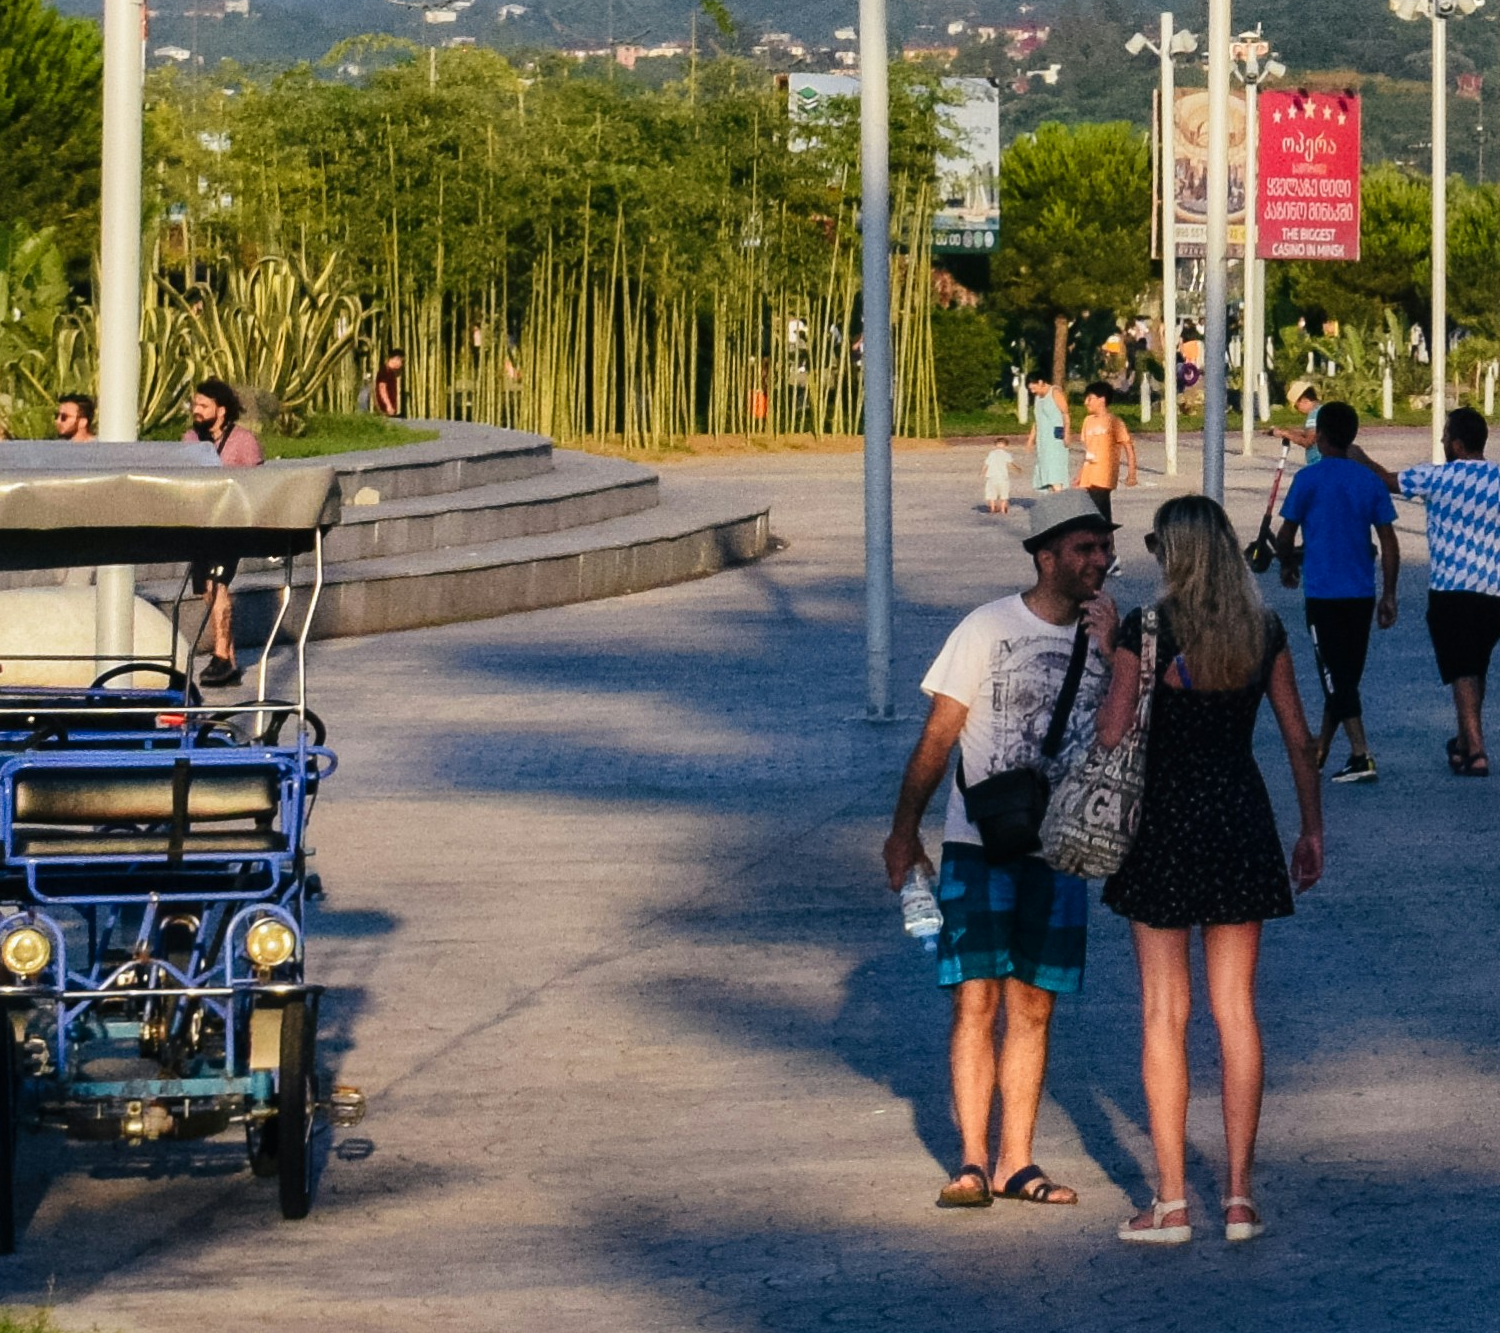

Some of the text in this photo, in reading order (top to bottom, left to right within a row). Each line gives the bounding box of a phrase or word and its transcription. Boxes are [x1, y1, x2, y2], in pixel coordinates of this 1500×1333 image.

[1282, 131, 1336, 163] ოპერა
[1266, 177, 1351, 198] ყველაზე დიდი
[1281, 228, 1336, 242] THE BIGGEST
[1271, 243, 1345, 257] CASINO IN MINSK
